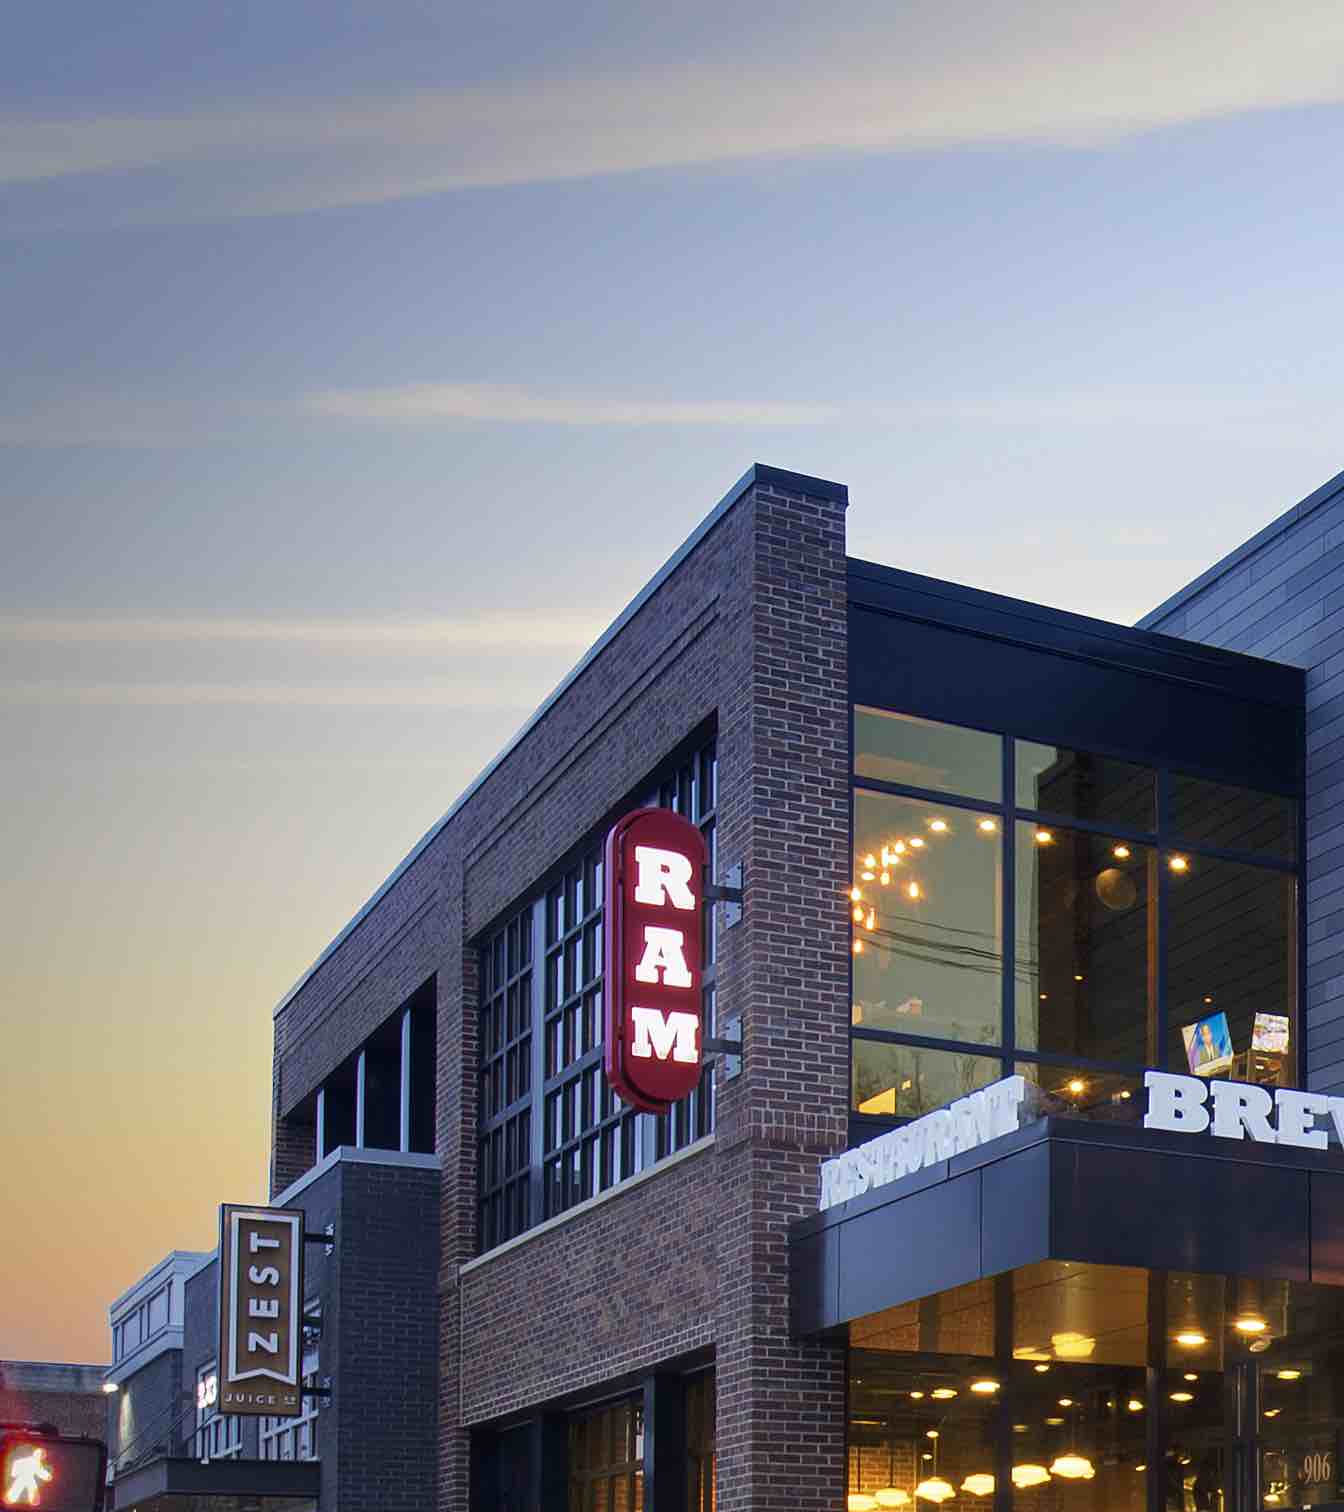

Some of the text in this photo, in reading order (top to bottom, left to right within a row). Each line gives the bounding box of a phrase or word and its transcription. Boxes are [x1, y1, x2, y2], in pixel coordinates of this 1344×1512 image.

[631, 845, 699, 1064] RAM
[247, 1230, 281, 1354] ZEST
[224, 1391, 277, 1405] JUICE
[1303, 1454, 1331, 1483] 906
